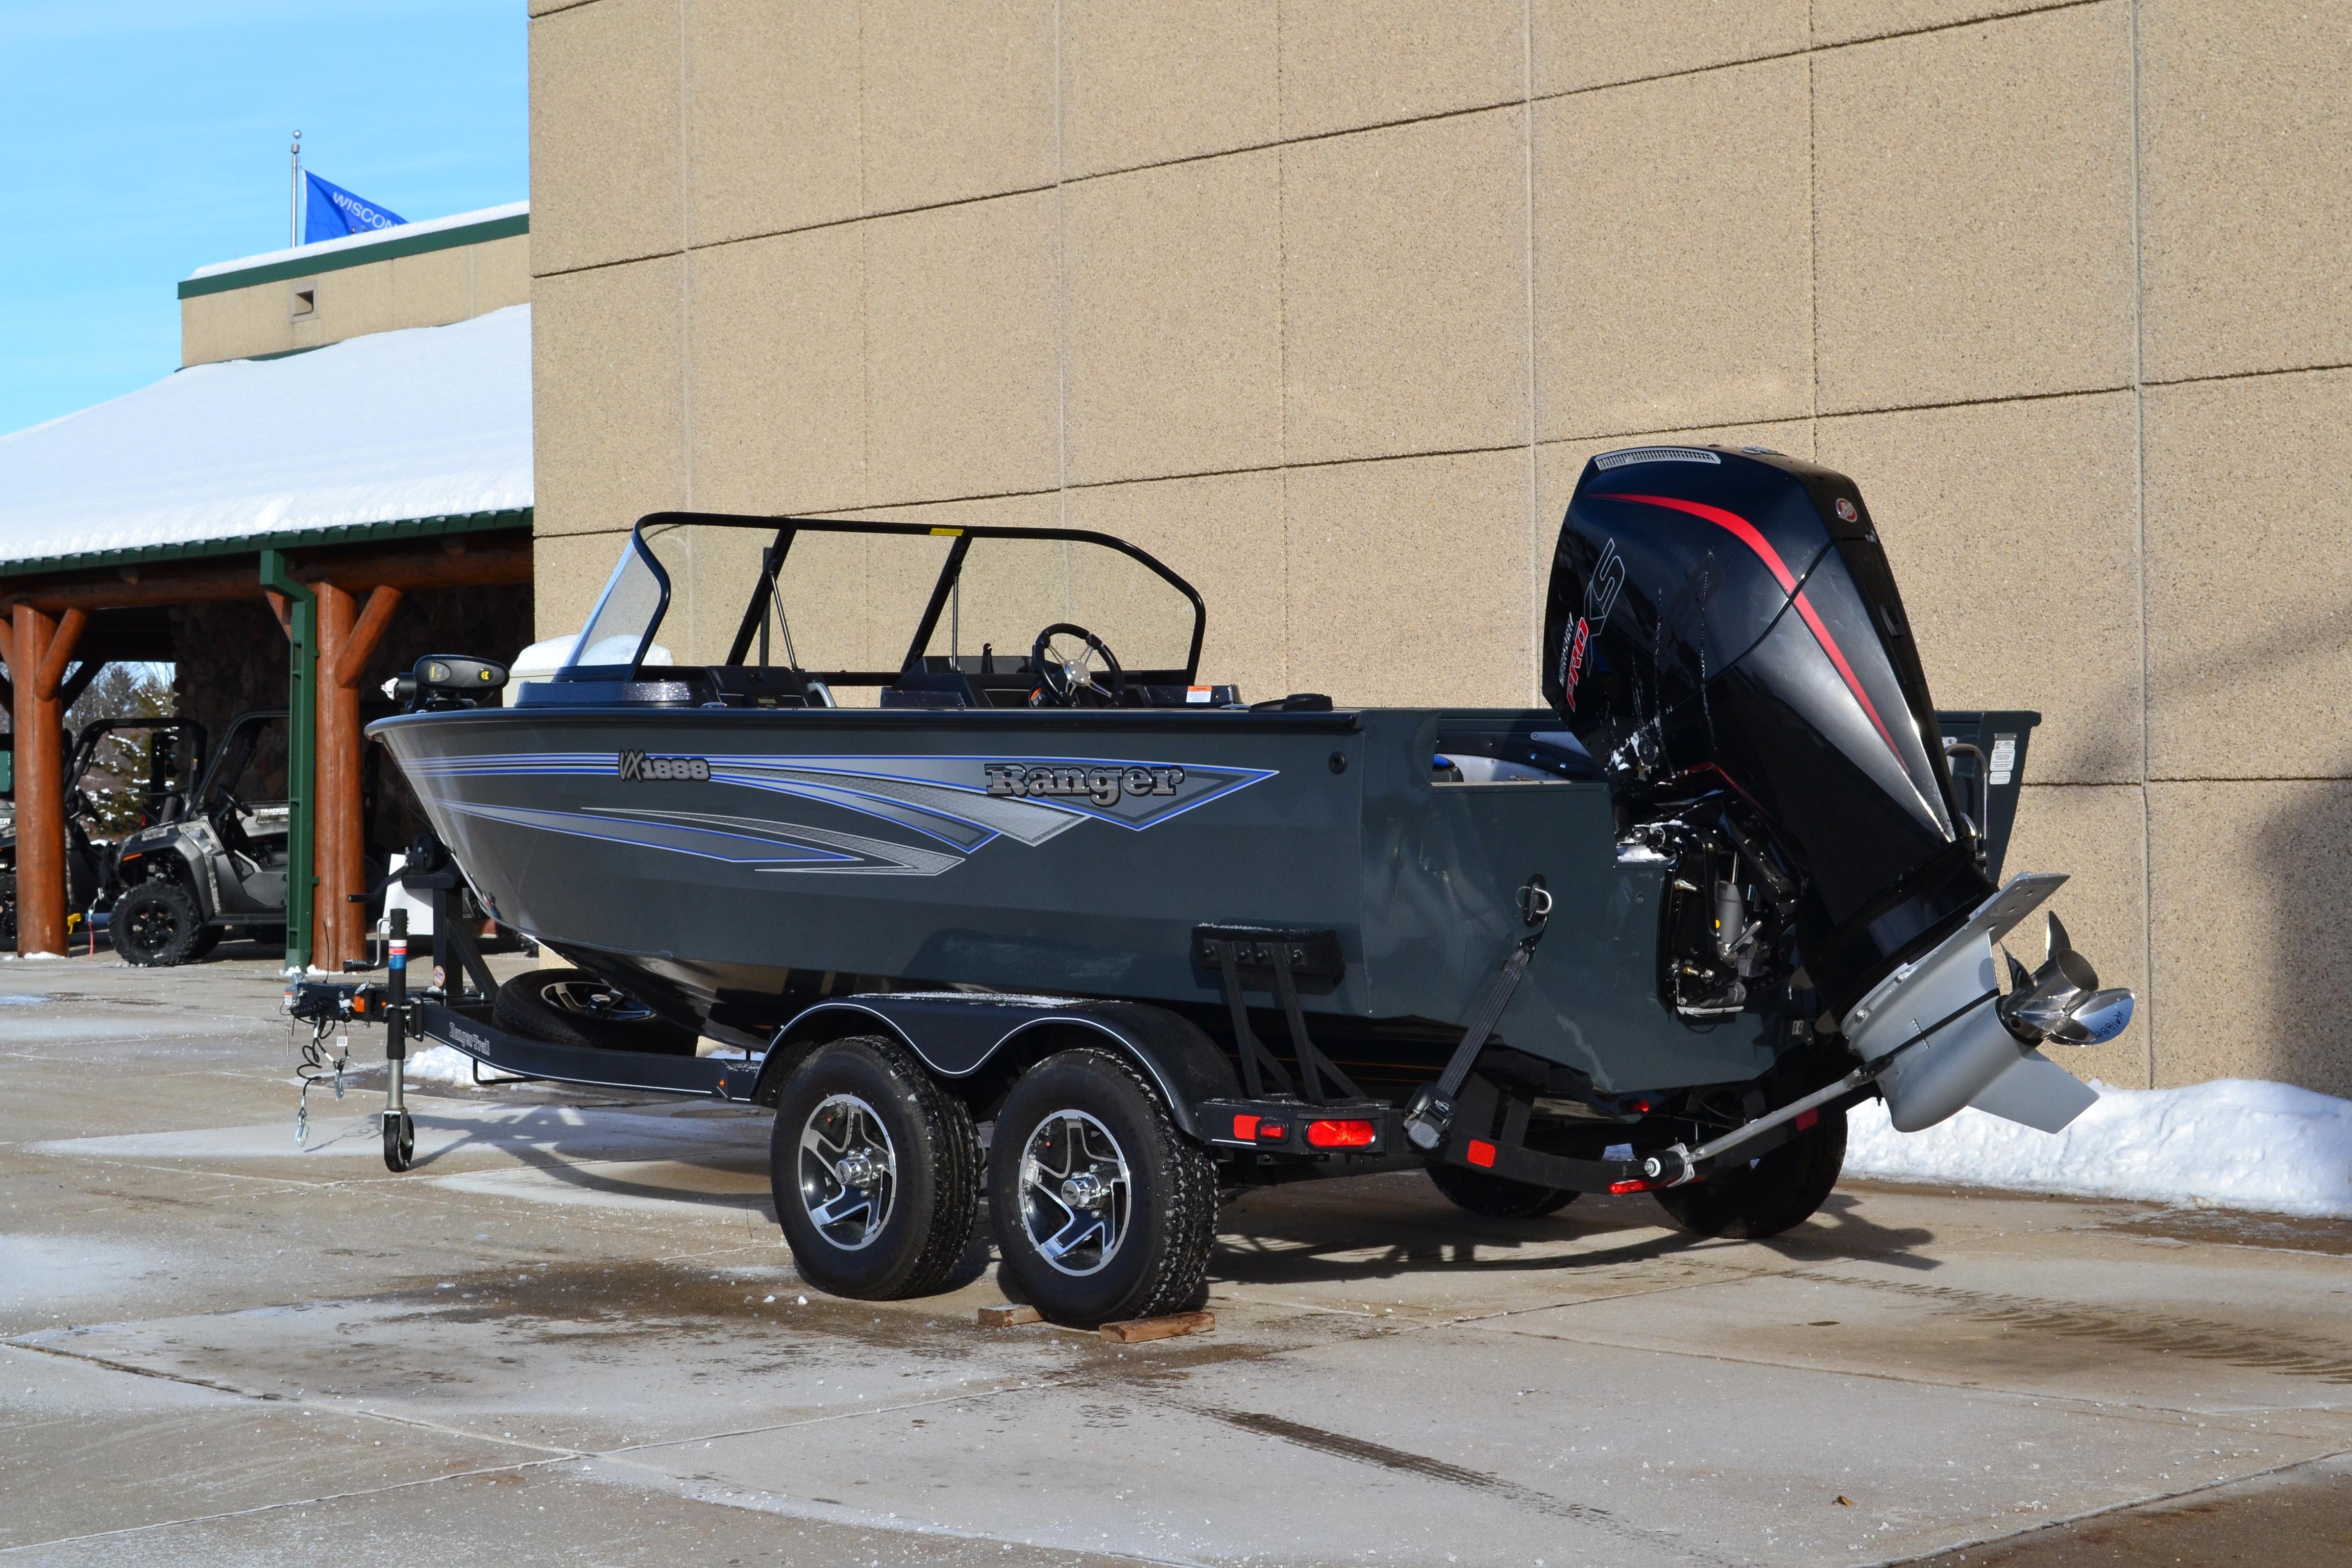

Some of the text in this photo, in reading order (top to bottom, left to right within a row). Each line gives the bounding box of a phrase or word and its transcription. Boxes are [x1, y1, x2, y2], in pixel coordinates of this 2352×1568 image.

[1566, 617, 1589, 713] PRO
[619, 750, 710, 781] VX1888
[984, 764, 1185, 807] Ranger
